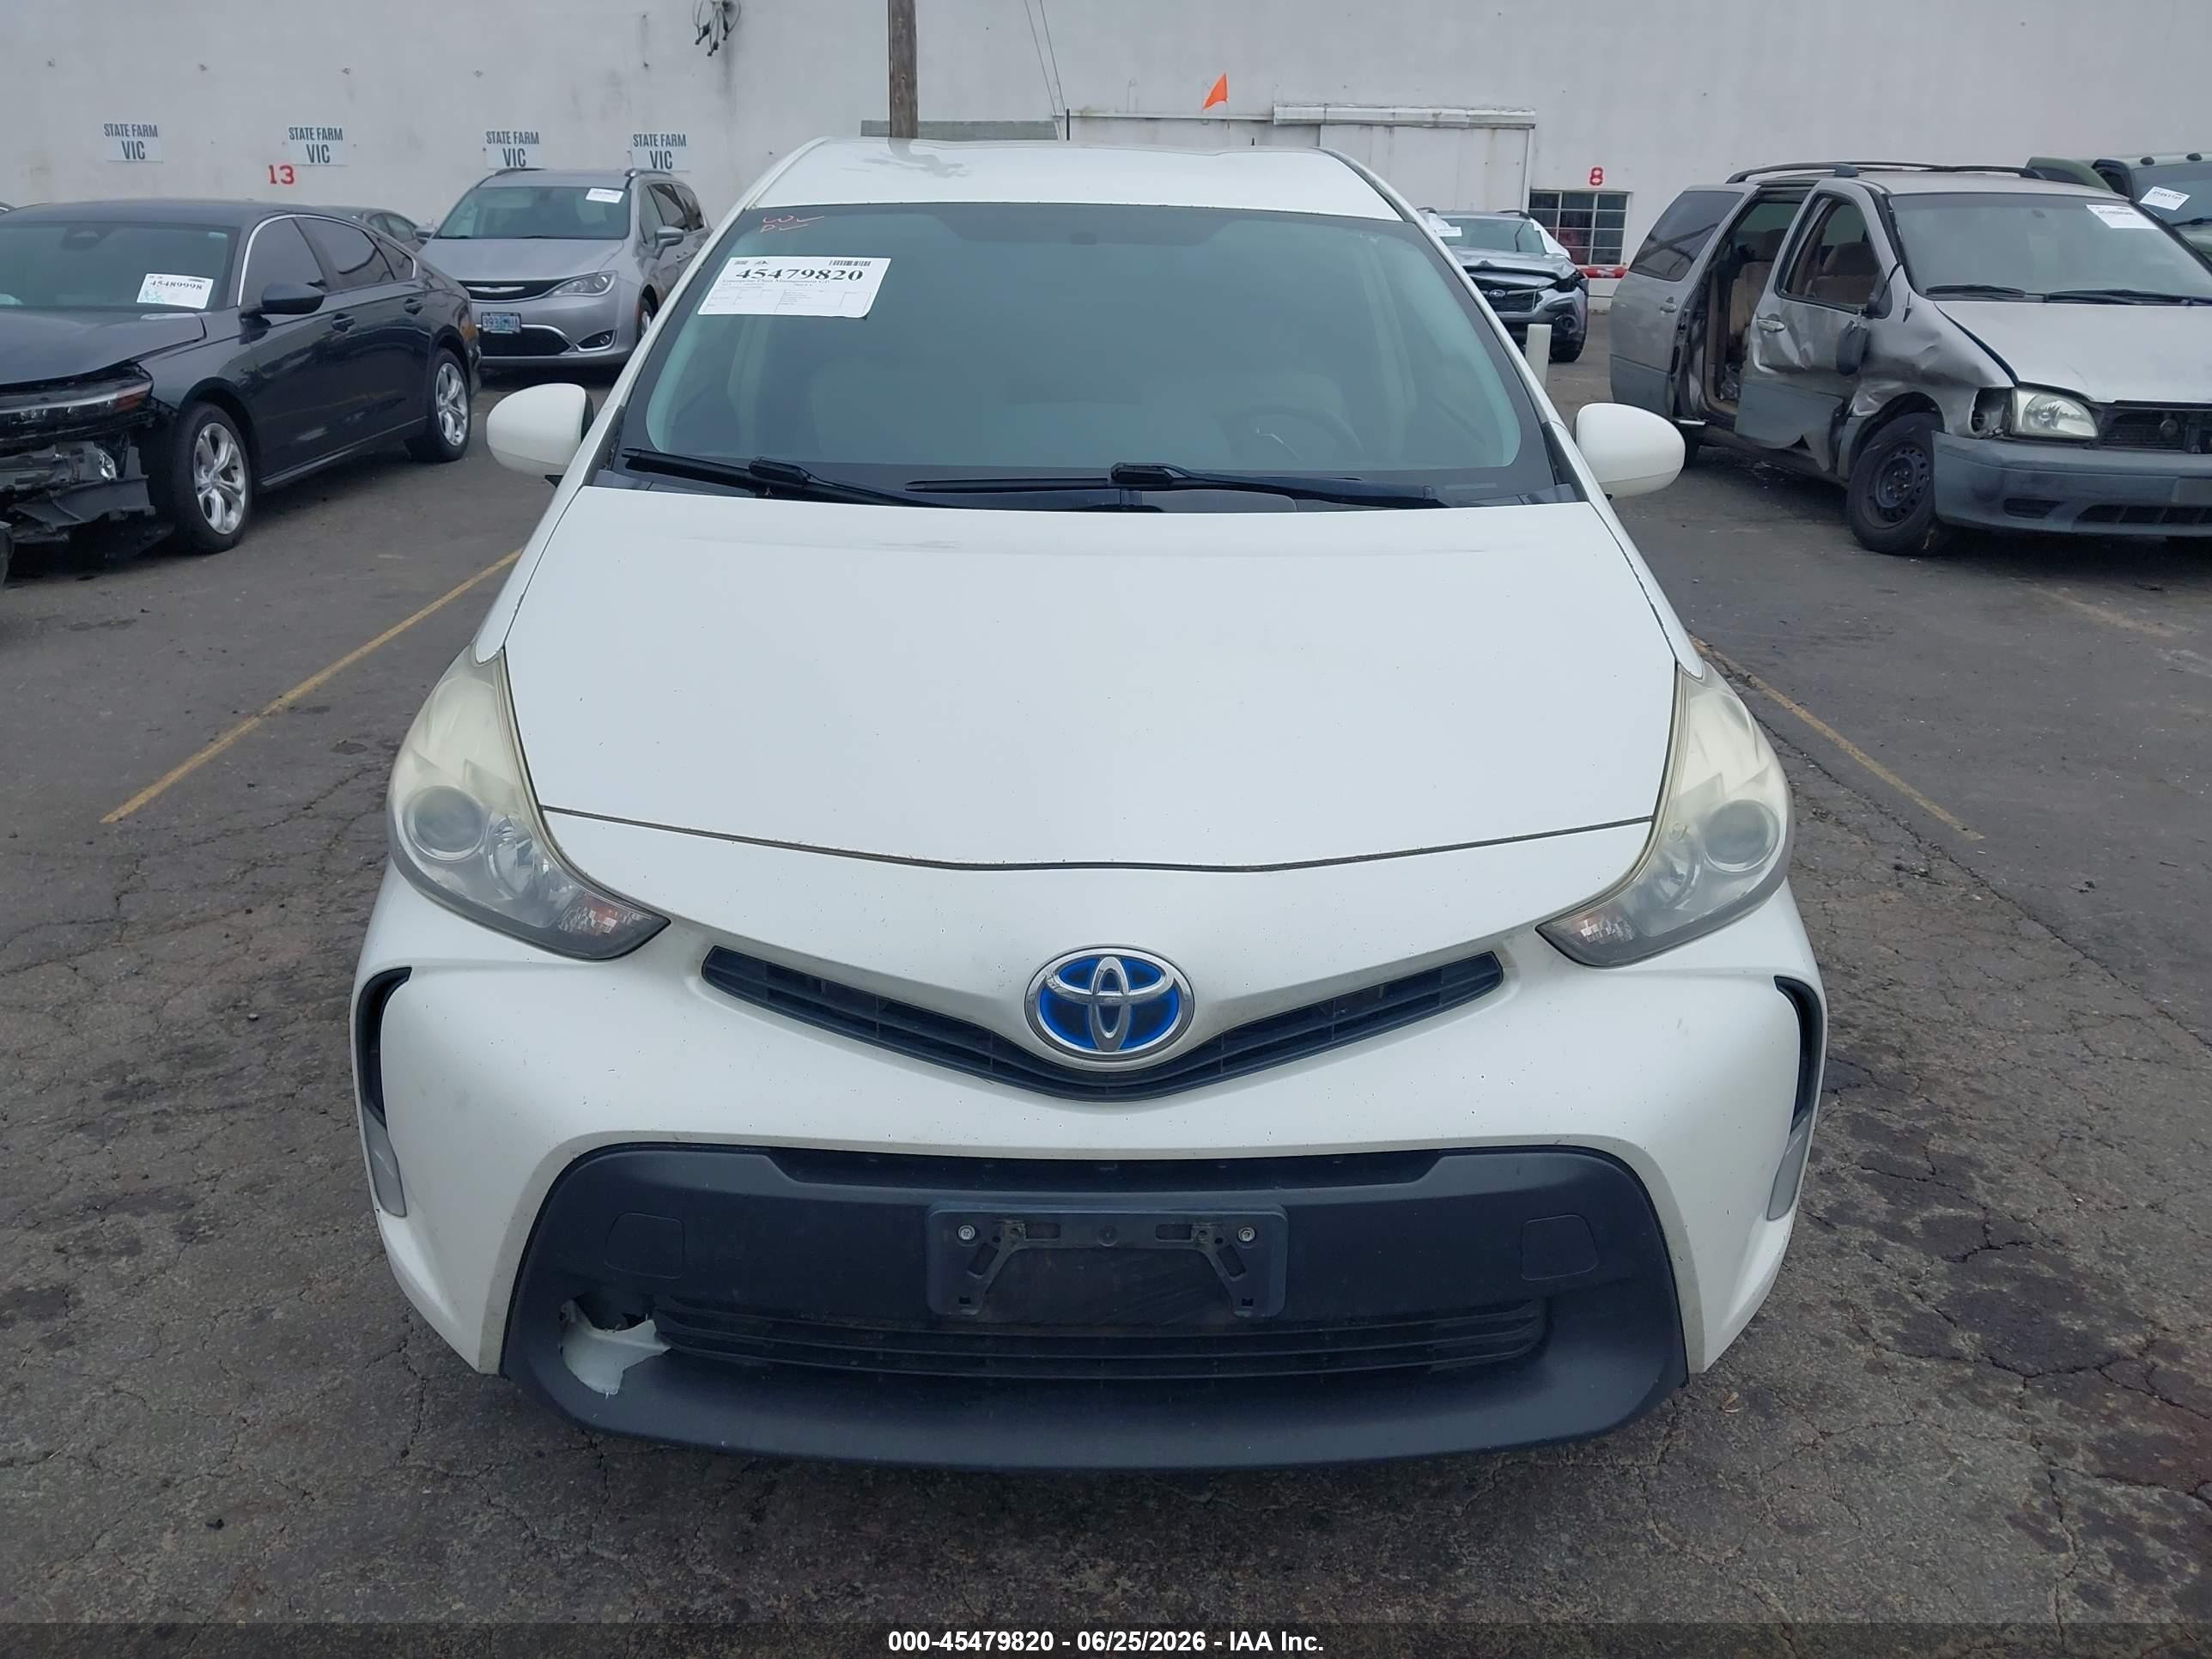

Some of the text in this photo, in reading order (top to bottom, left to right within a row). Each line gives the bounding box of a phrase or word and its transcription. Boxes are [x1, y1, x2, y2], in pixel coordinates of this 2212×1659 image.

[104, 123, 158, 137] STATE FARM
[288, 126, 343, 141] STATE FARM
[486, 131, 539, 145] STATE FARM
[632, 133, 687, 148] STATE FARM
[121, 140, 145, 161] VIC
[306, 144, 331, 163] VIC
[502, 148, 526, 167] VIC
[649, 150, 673, 169] VIC
[268, 165, 295, 185] 13
[1589, 167, 1604, 186] 8
[735, 268, 864, 282] 45479820
